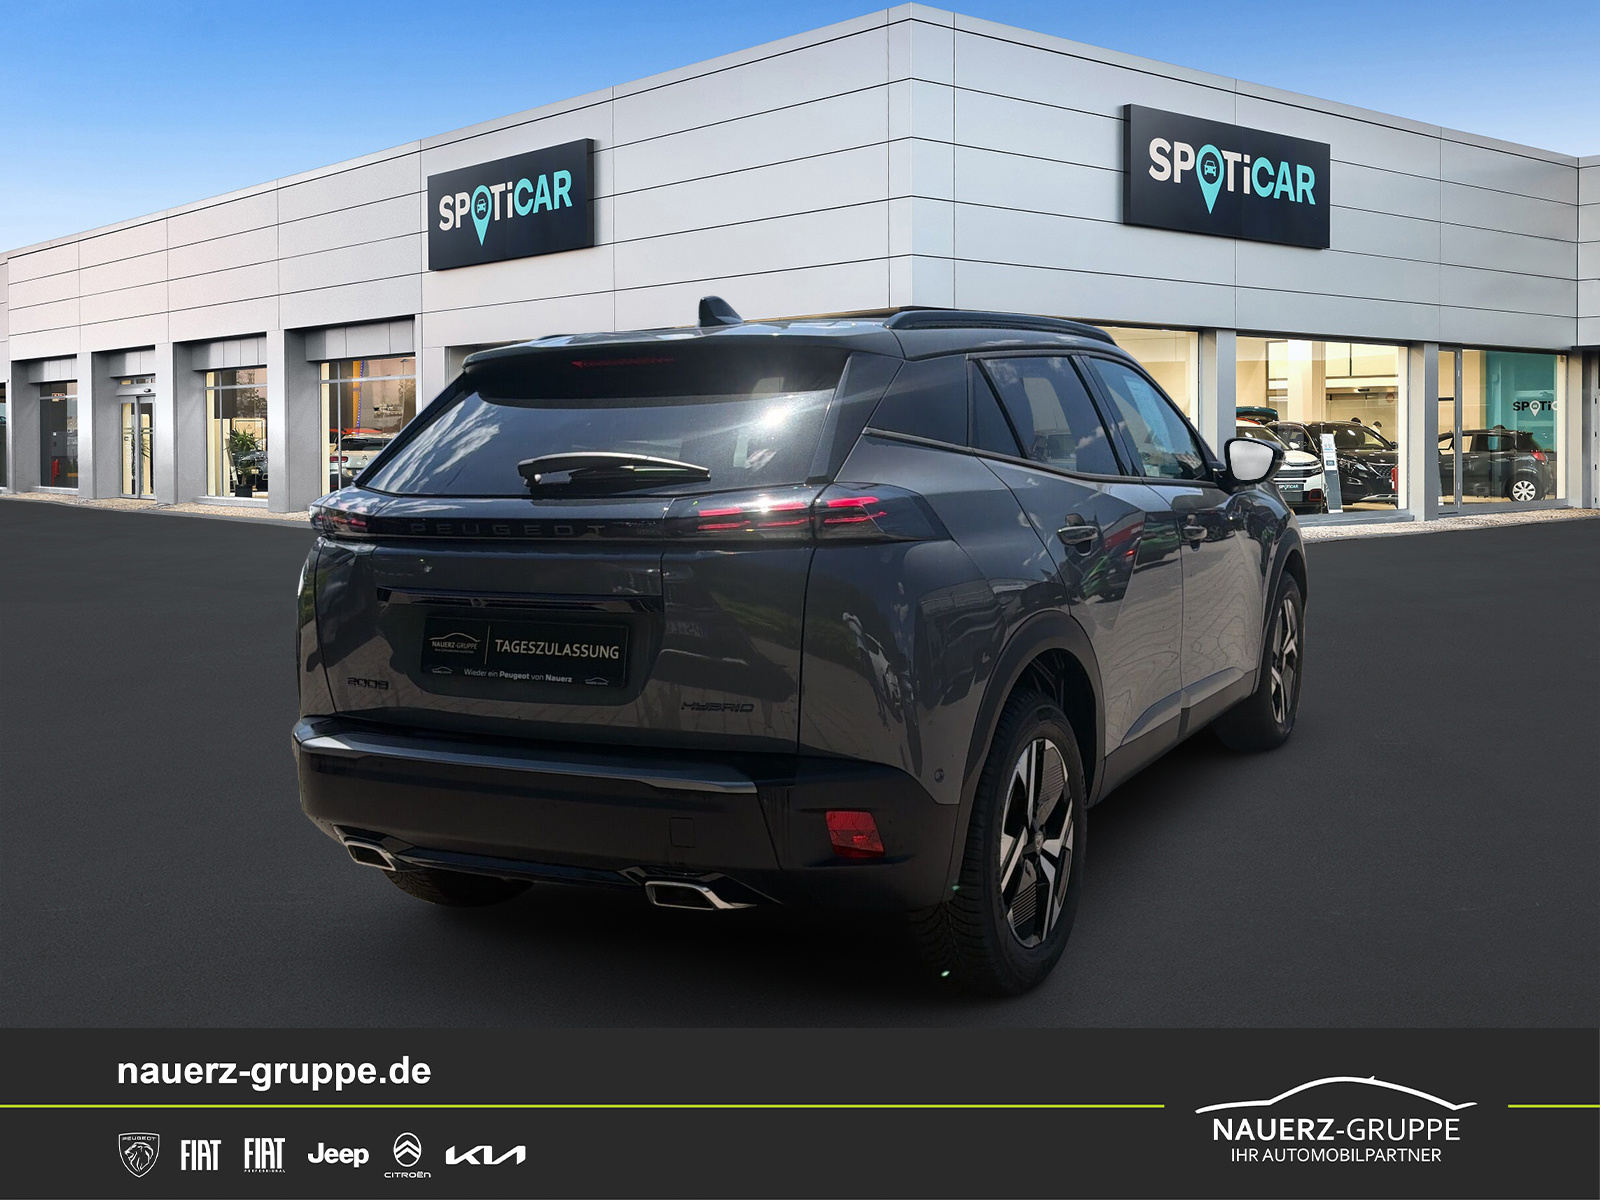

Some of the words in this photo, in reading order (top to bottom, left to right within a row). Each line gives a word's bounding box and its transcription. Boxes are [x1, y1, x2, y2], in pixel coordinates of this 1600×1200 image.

[409, 522, 606, 537] PEUGEOT
[432, 640, 478, 650] NAUERZ-GRUPPE
[496, 639, 619, 659] TAGESZULASSUNG
[464, 668, 487, 677] Wieder
[487, 669, 499, 678] ein
[499, 670, 530, 681] Peugeot
[545, 674, 573, 683] Nauerz
[681, 701, 755, 713] HYBRID
